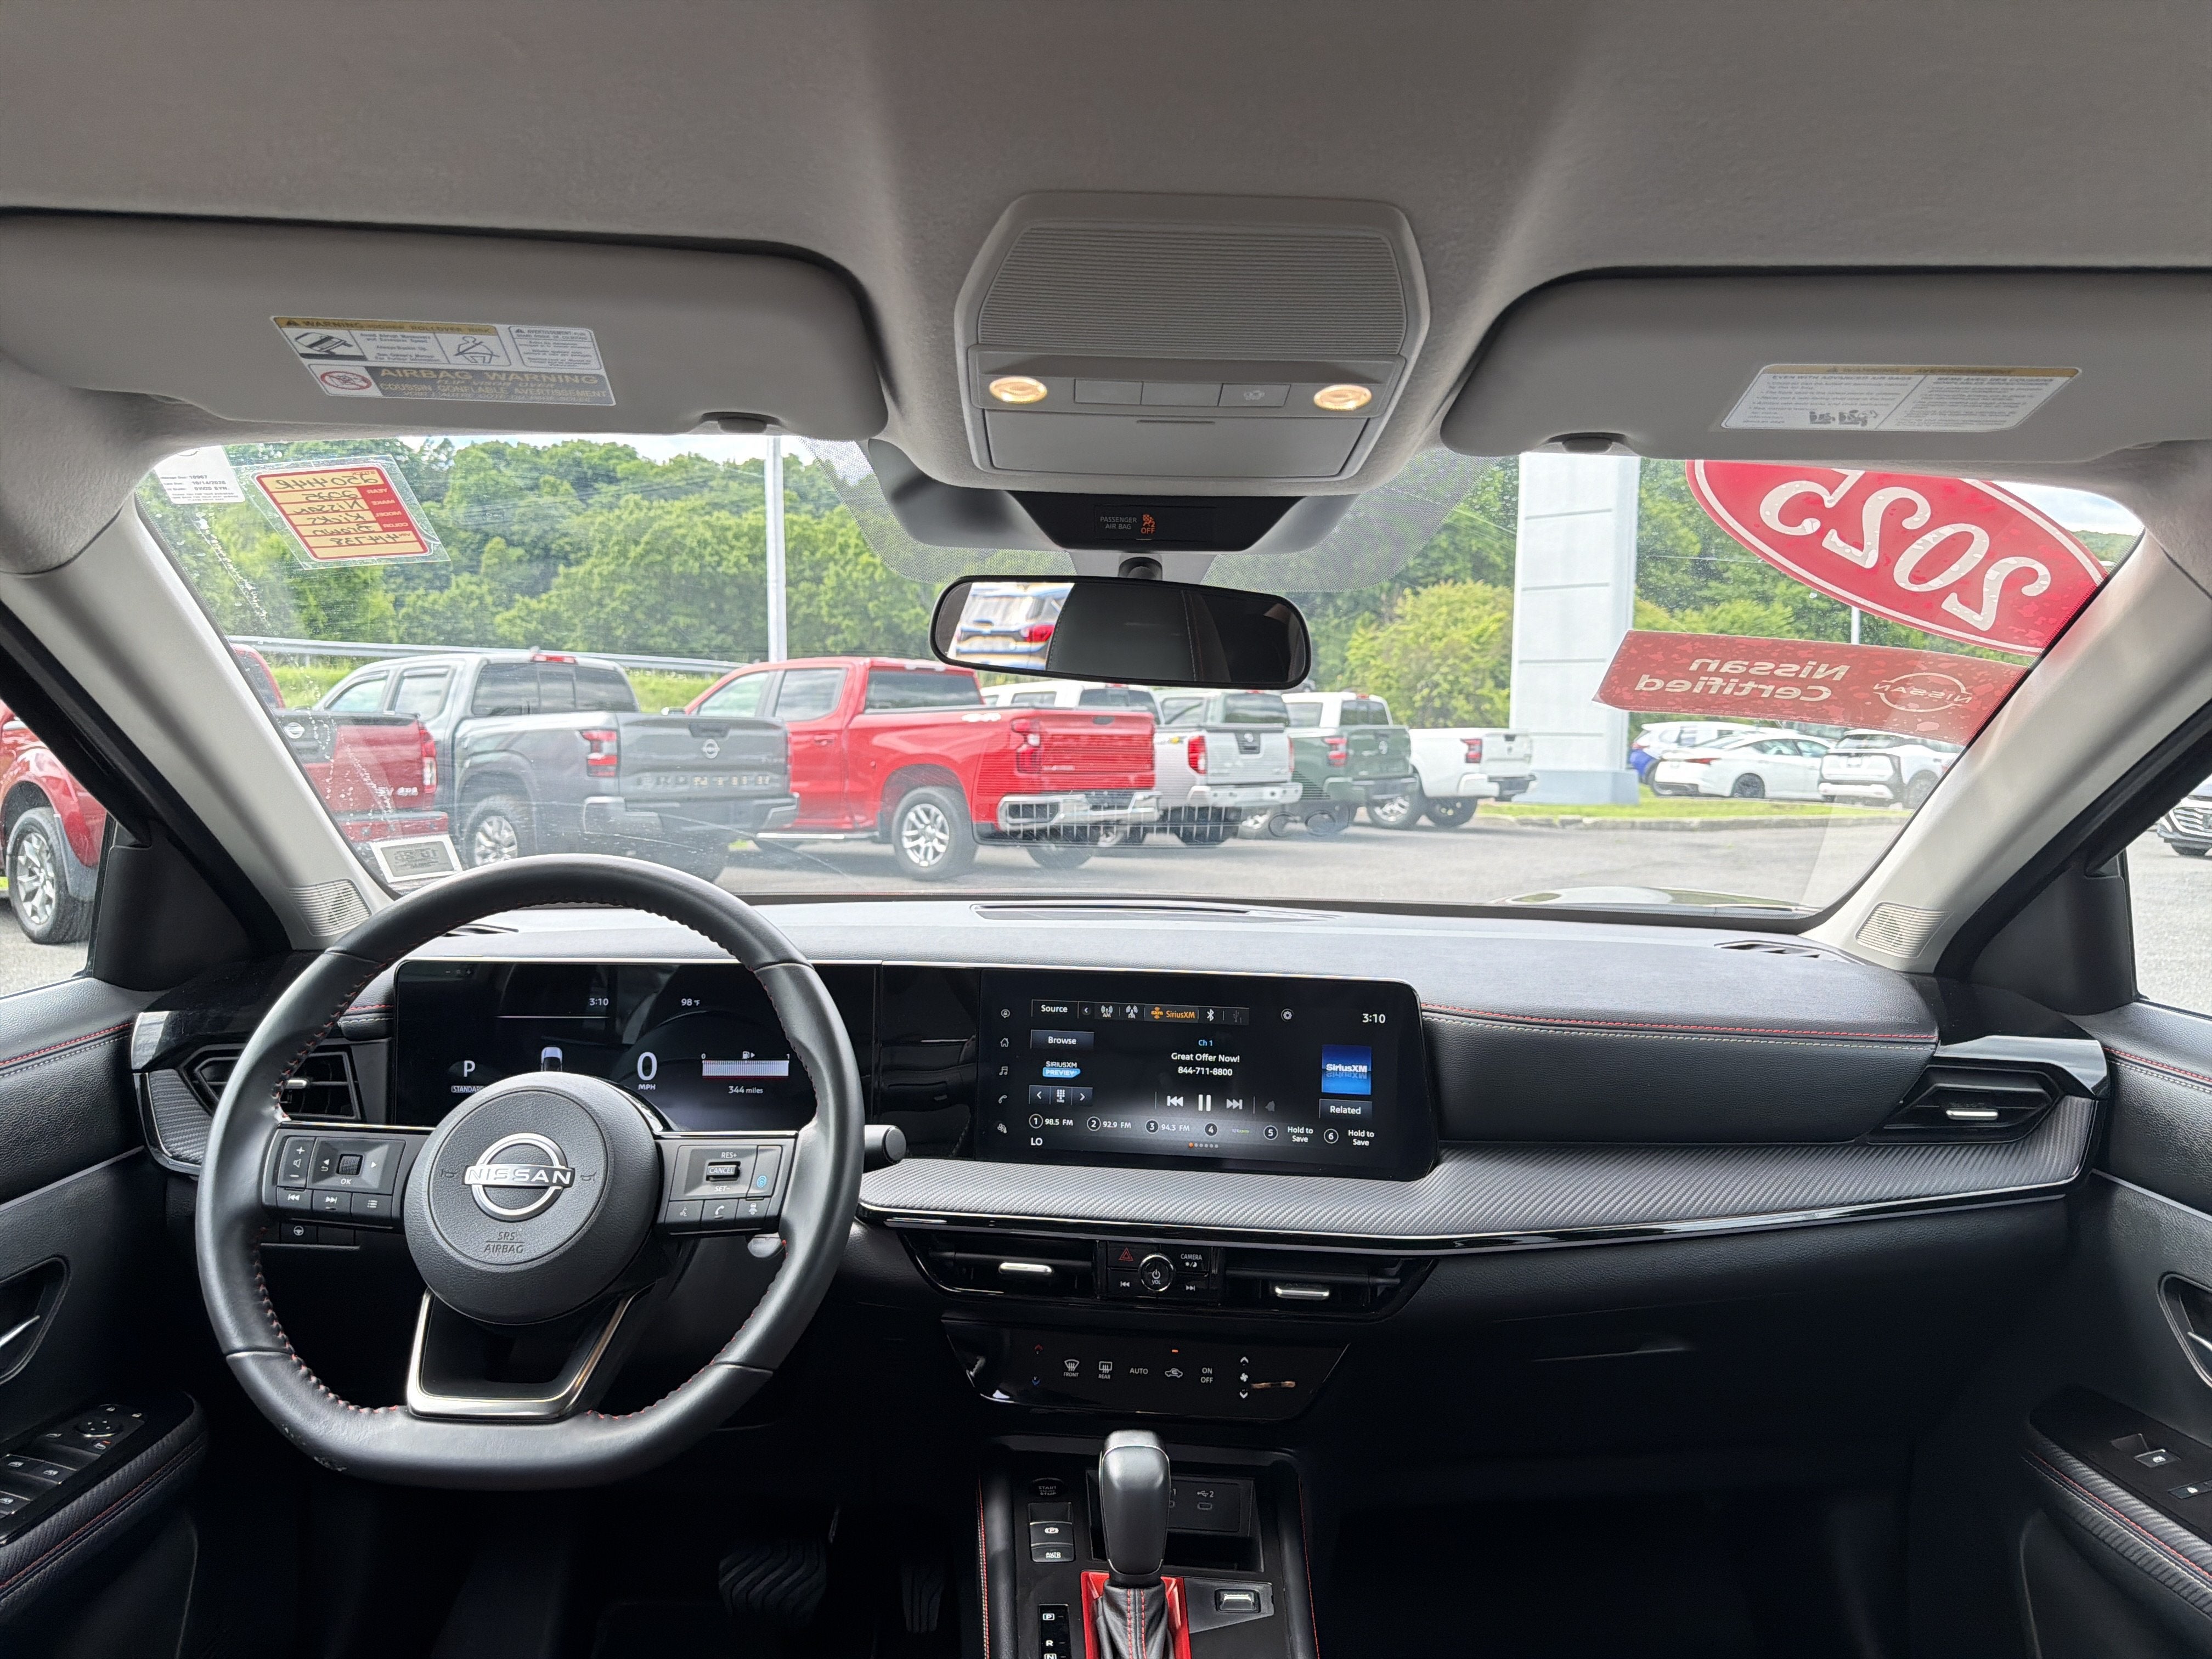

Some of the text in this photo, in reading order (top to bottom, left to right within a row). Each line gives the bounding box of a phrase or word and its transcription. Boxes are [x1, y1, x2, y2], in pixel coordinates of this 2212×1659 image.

[381, 368, 599, 384] AIRBAG WARNING
[1041, 1005, 1068, 1013] Source
[1166, 1011, 1195, 1019] SiriusXM
[1362, 1013, 1386, 1024] 3:10
[1048, 1036, 1077, 1045] Browse
[1171, 1052, 1194, 1061] Great
[464, 1060, 476, 1077] P
[637, 1052, 657, 1081] 0
[1178, 1066, 1233, 1076] 844-711-8800
[1325, 1063, 1368, 1073] SiriusXM
[1330, 1105, 1361, 1115] Related
[1030, 1137, 1043, 1146] LO
[467, 1168, 571, 1184] NISSAN
[498, 1232, 515, 1241] SRS
[484, 1244, 523, 1254] AIRBAG
